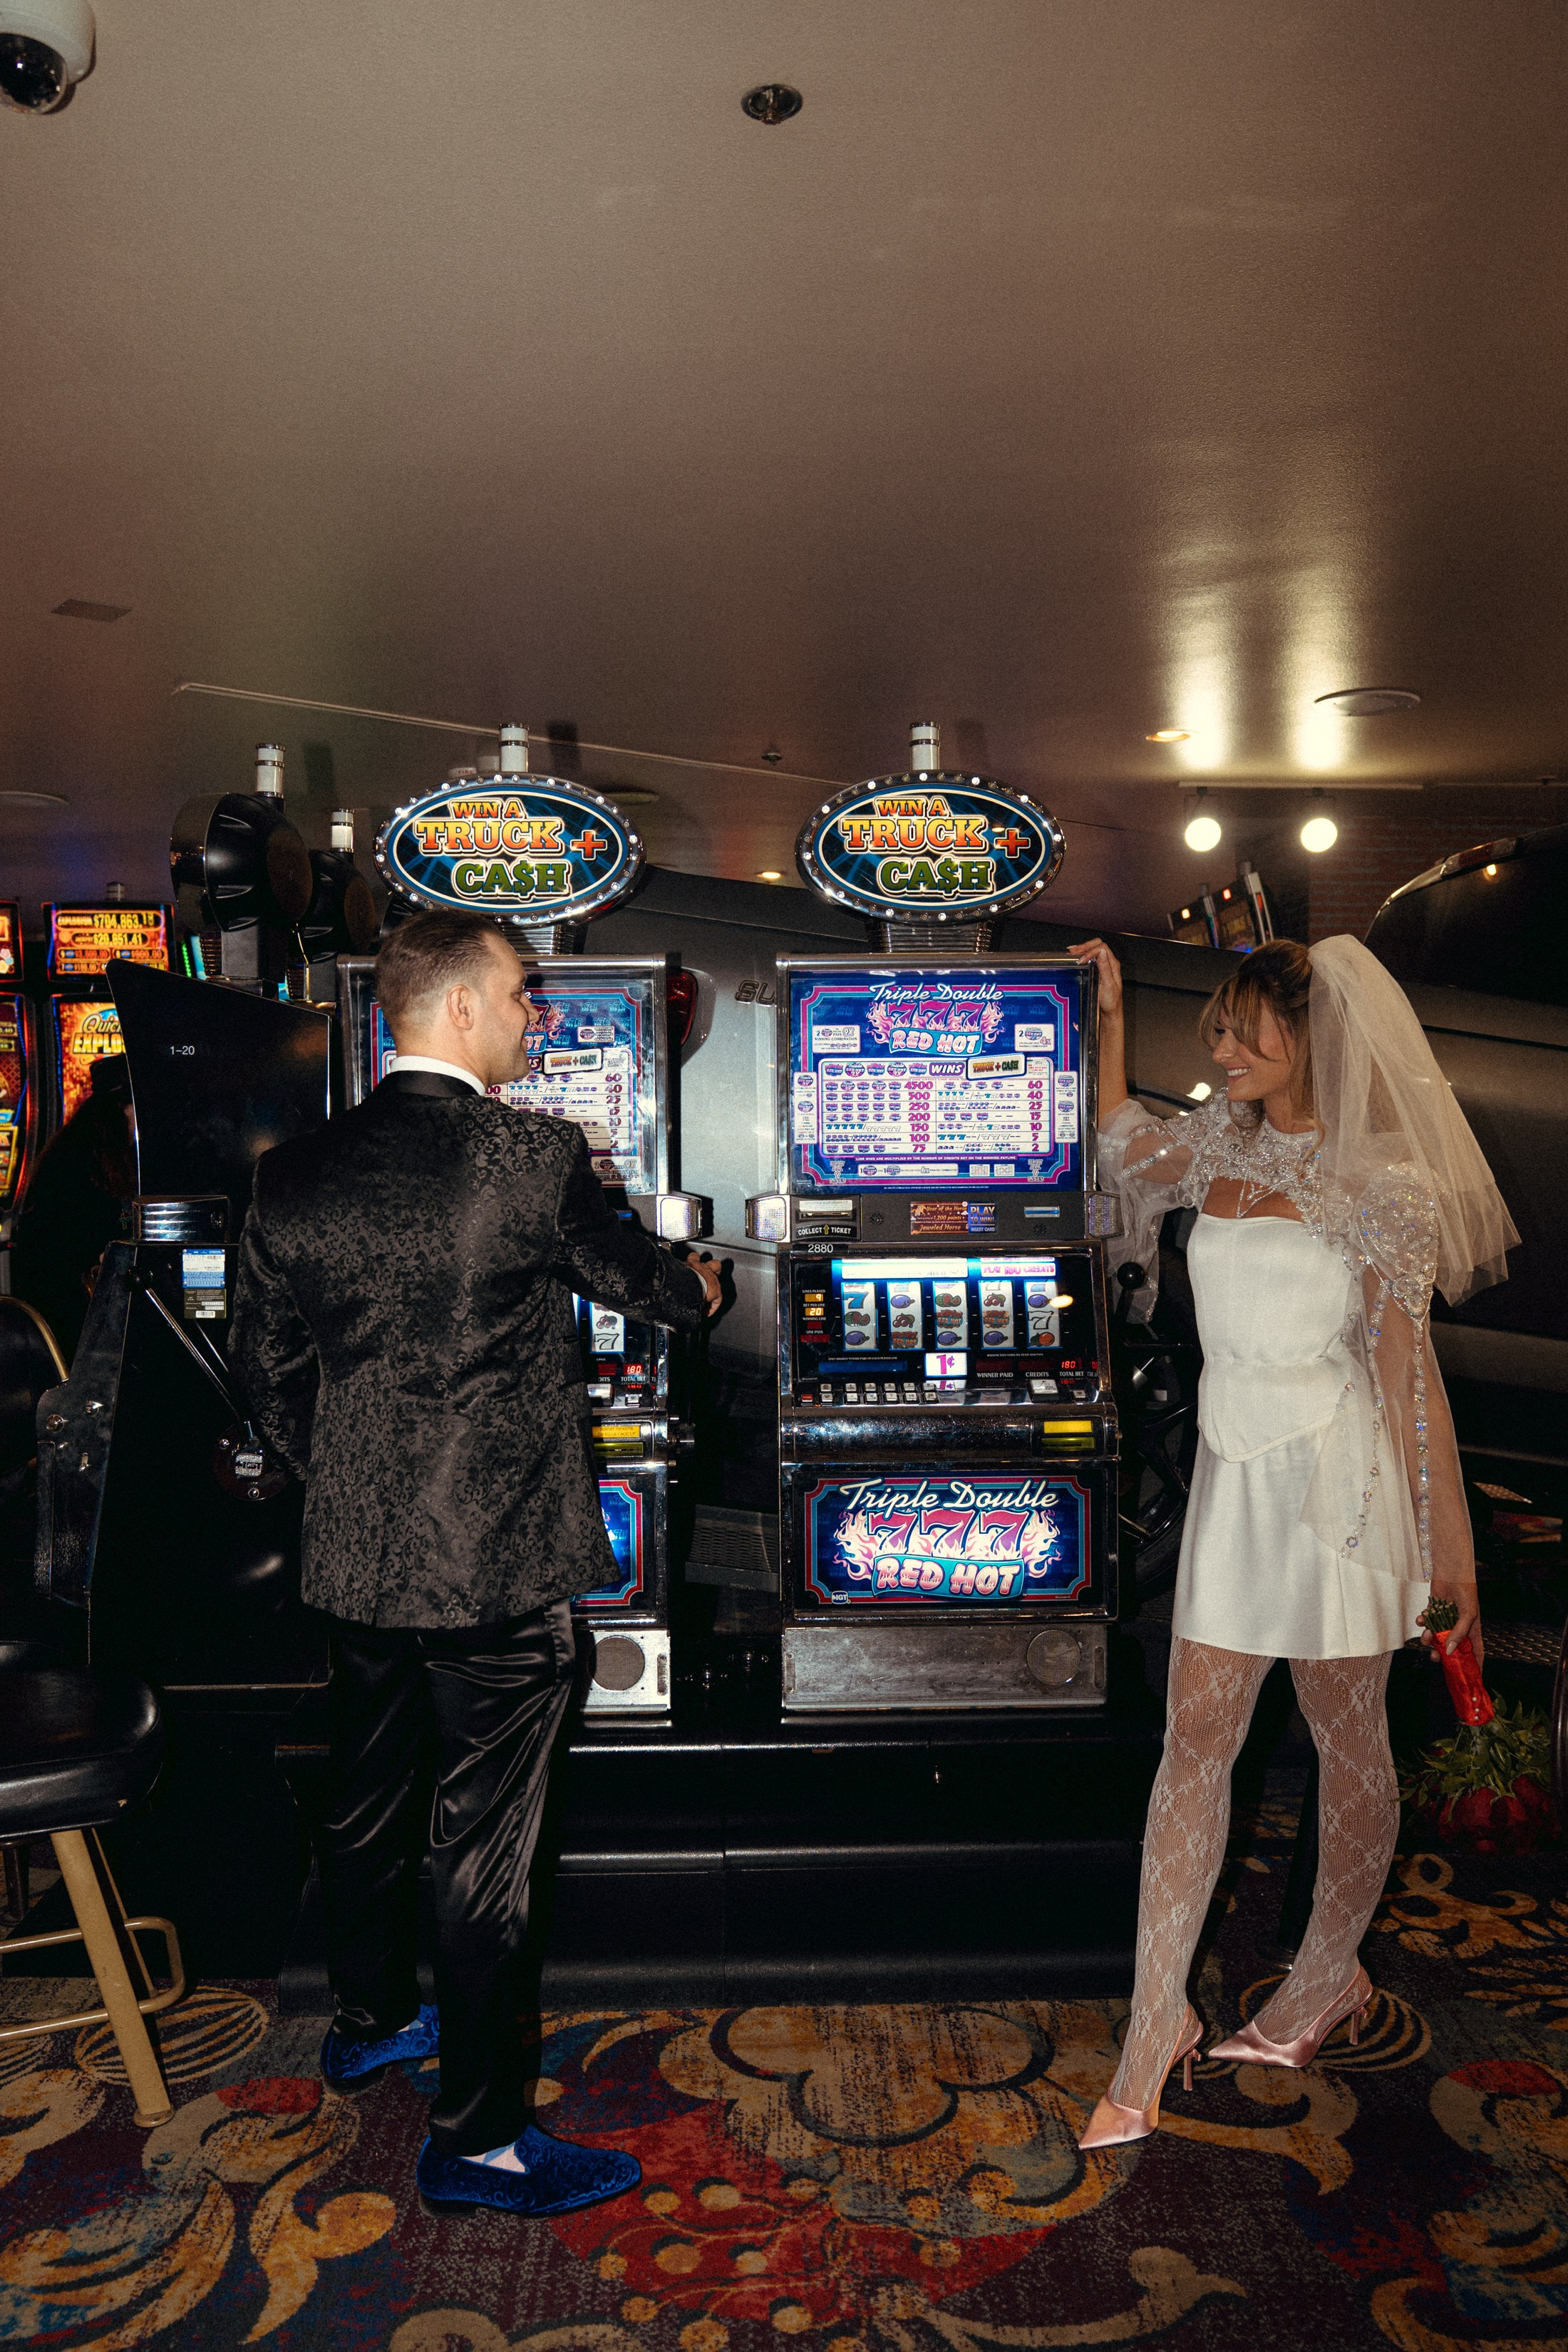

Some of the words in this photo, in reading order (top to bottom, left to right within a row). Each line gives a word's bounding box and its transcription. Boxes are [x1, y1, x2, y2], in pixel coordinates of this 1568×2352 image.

[452, 801, 499, 819] WIN
[505, 801, 522, 819] A
[877, 799, 924, 817] WIN
[929, 799, 947, 817] A
[417, 820, 559, 850] TRUCK
[842, 817, 984, 848] TRUCK
[455, 860, 567, 896] CA$H
[880, 857, 991, 894] CA$H
[869, 981, 930, 1006] Triple
[933, 983, 1004, 1001] Double
[73, 1033, 126, 1054] EXPLO
[892, 1030, 934, 1050] RED
[937, 1034, 980, 1054] HOT
[550, 1056, 572, 1067] TRUCK
[579, 1054, 597, 1066] CA$H
[931, 1064, 962, 1074] WINS
[973, 1062, 994, 1073] TRUCK
[1001, 1060, 1019, 1072] CA$H
[604, 1073, 622, 1083] 60
[604, 1084, 623, 1094] 40
[904, 1081, 934, 1090] 4500
[1027, 1080, 1043, 1089] 60
[606, 1095, 621, 1105] 25
[908, 1092, 931, 1100] 500
[1027, 1091, 1043, 1100] 40
[908, 1102, 930, 1110] 250
[1028, 1101, 1043, 1110] 25
[908, 1113, 931, 1121] 200
[1029, 1112, 1041, 1120] 15
[607, 1117, 621, 1126] 10
[1029, 1122, 1043, 1131] 10
[910, 1123, 929, 1132] 150
[610, 1128, 618, 1138] 5
[909, 1133, 930, 1142] 100
[1032, 1133, 1039, 1142] 5
[610, 1139, 619, 1149] 2
[912, 1144, 927, 1153] 75
[1031, 1143, 1039, 1152] 2
[970, 1206, 995, 1216] PLAY
[808, 1244, 834, 1253] 2880
[1004, 1266, 1022, 1275] 180
[627, 1365, 641, 1373] 180
[936, 1354, 954, 1375] 1¢
[840, 1478, 939, 1518] Triple
[943, 1479, 1058, 1508] Double
[867, 1508, 1033, 1558] 777
[877, 1558, 944, 1589] RED
[949, 1564, 1020, 1594] HOT
